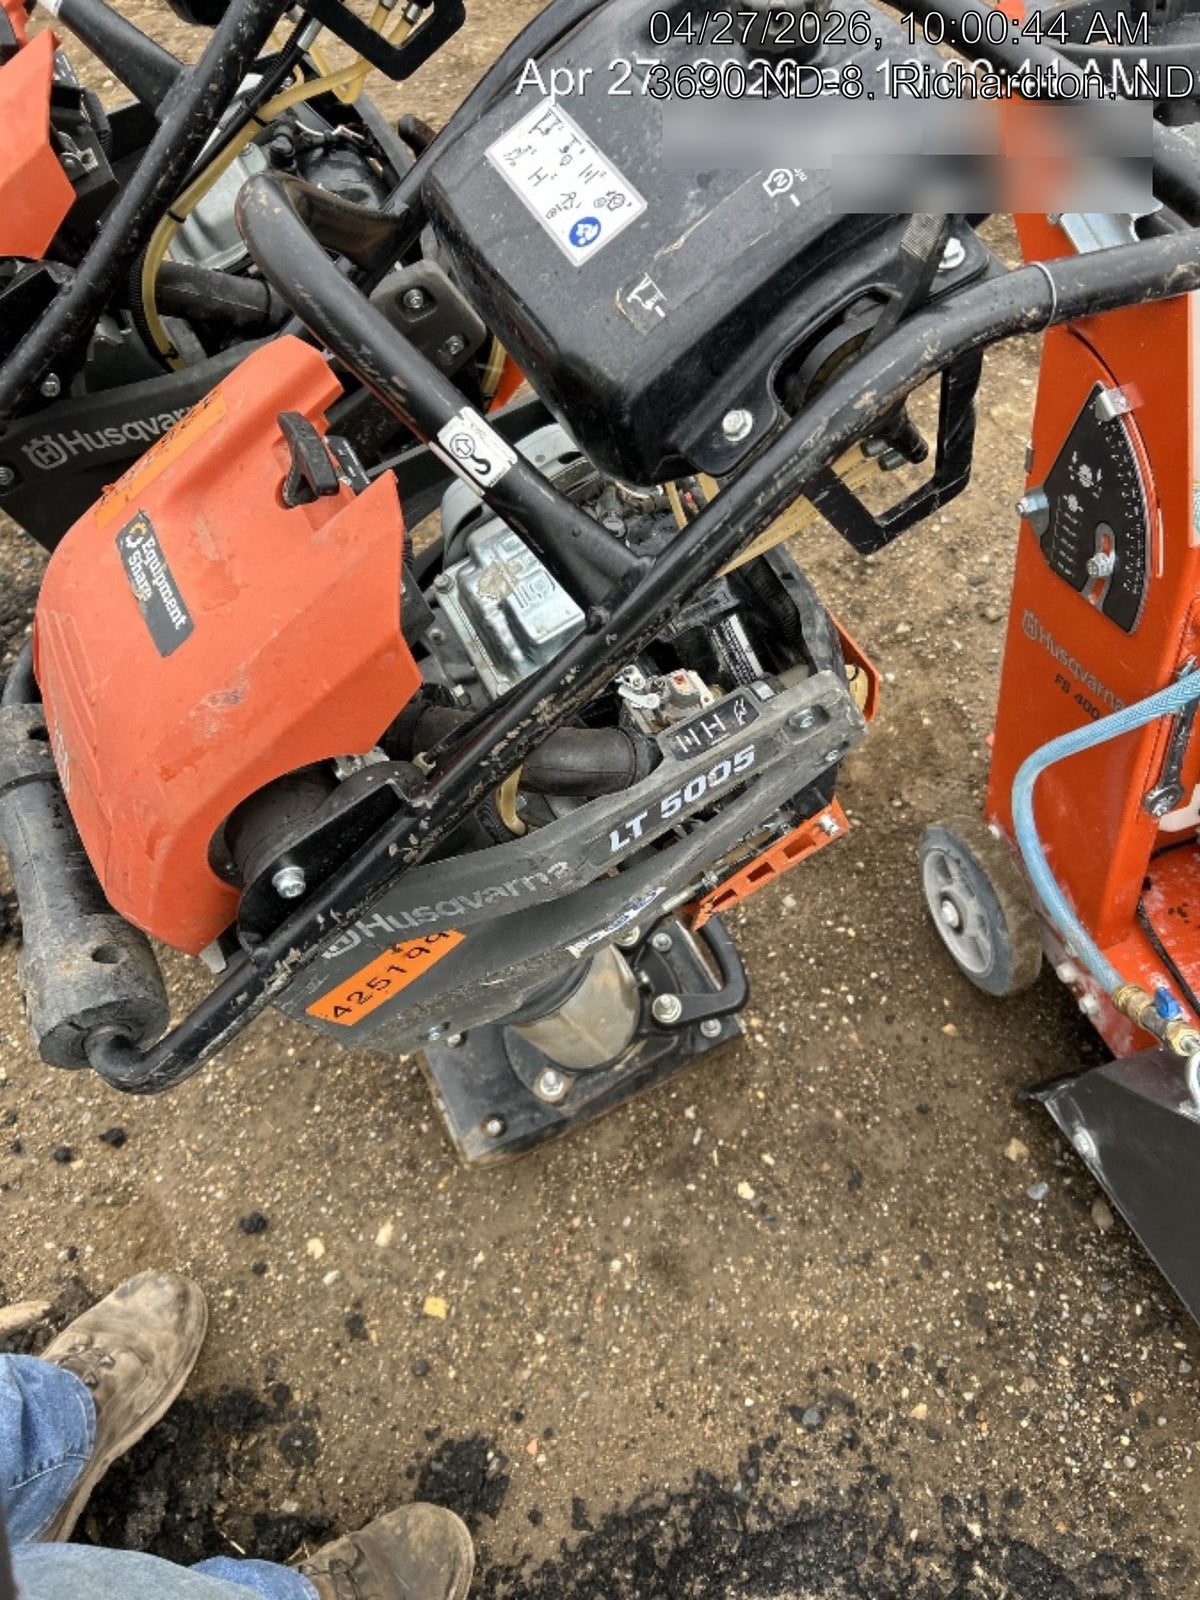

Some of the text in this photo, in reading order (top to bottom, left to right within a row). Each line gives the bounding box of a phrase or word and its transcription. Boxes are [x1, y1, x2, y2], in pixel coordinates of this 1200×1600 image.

[58, 405, 197, 456] Husqvar
[128, 548, 153, 602] Share
[141, 534, 187, 631] Equipment
[608, 744, 755, 853] LT 5005
[331, 931, 441, 1020] 425199
